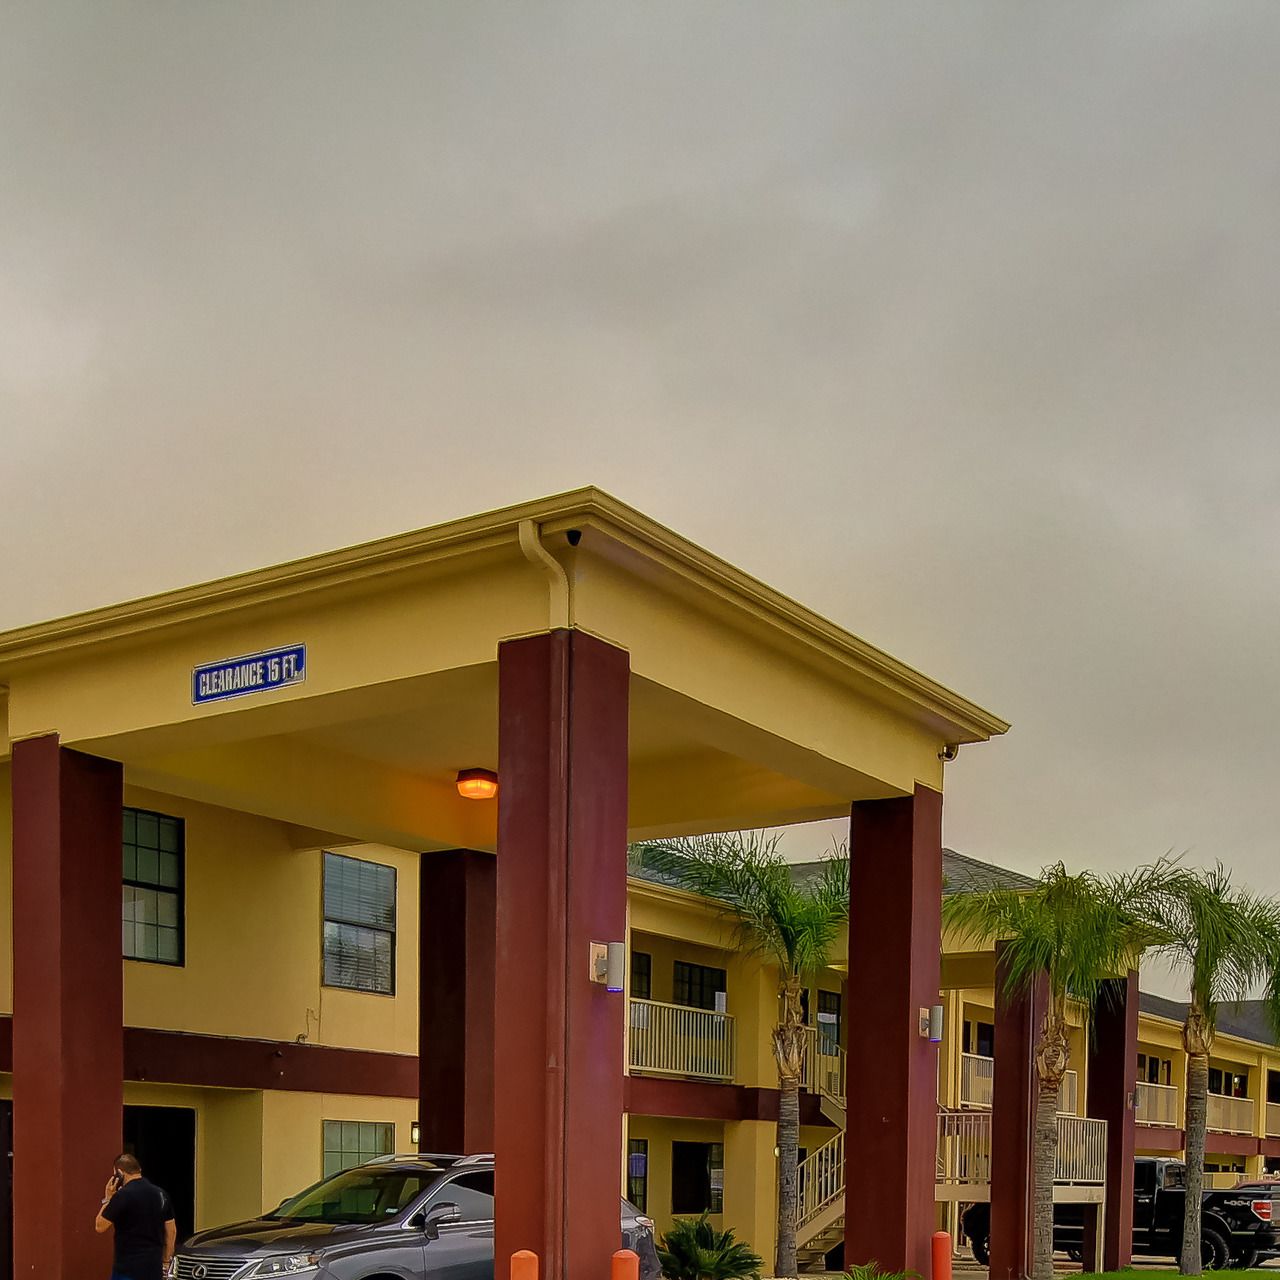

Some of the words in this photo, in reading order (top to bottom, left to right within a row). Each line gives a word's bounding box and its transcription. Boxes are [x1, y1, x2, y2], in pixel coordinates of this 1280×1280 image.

[200, 661, 264, 696] CLEARANCE
[267, 658, 280, 682] 15
[282, 654, 298, 679] FT.
